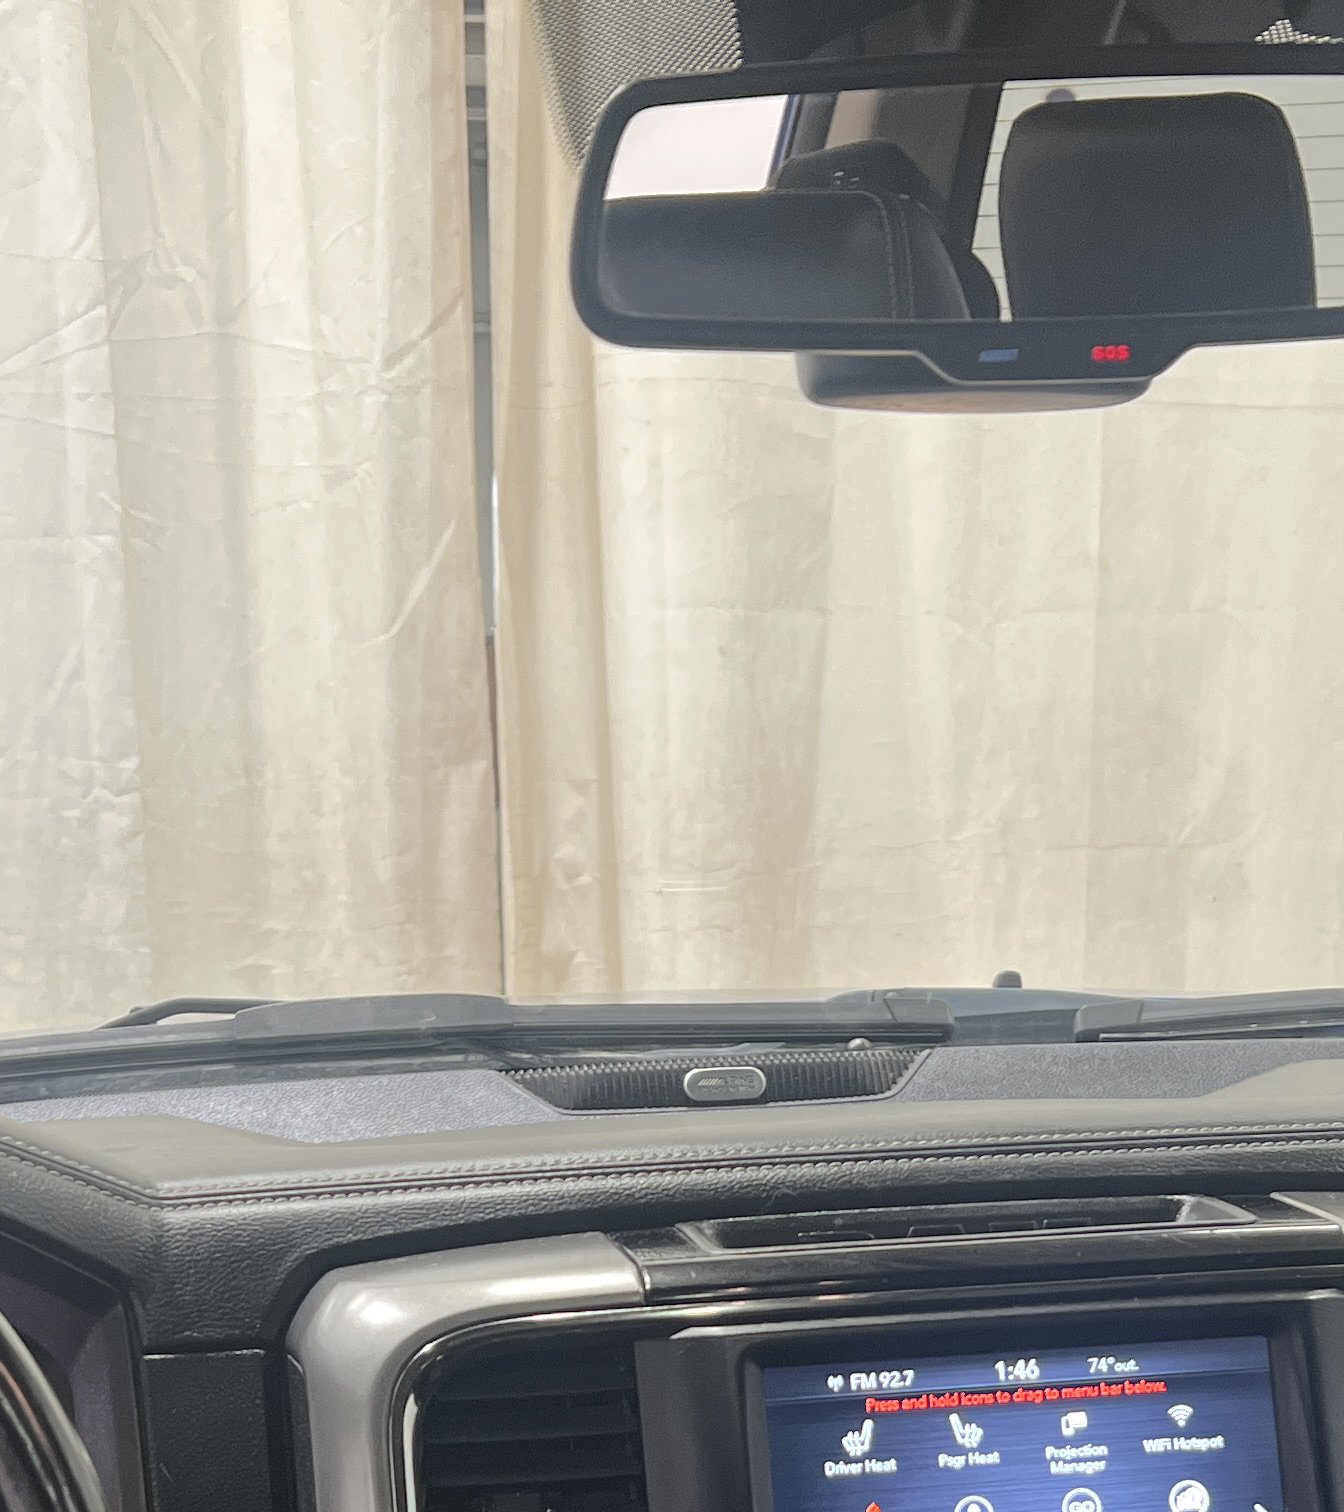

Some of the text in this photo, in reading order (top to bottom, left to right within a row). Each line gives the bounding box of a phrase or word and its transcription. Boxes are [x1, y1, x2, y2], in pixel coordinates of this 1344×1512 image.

[1091, 345, 1130, 361] SOS
[850, 1369, 914, 1390] FM 92.7
[995, 1358, 1040, 1381] 1:46
[865, 1397, 899, 1413] Press
[902, 1394, 928, 1410] and
[929, 1392, 959, 1408] hold
[960, 1392, 995, 1406] icons
[996, 1390, 1011, 1403] to
[1012, 1387, 1043, 1404] drag
[1044, 1387, 1060, 1400] to
[1061, 1385, 1099, 1398] menu
[1099, 1381, 1123, 1396] bar
[1045, 1443, 1109, 1460] Projection
[1142, 1435, 1225, 1454] WiFi Hotspot
[824, 1458, 898, 1478] Driver Heat
[938, 1450, 1001, 1471] Psgr Heat
[1050, 1459, 1107, 1475] Manager
